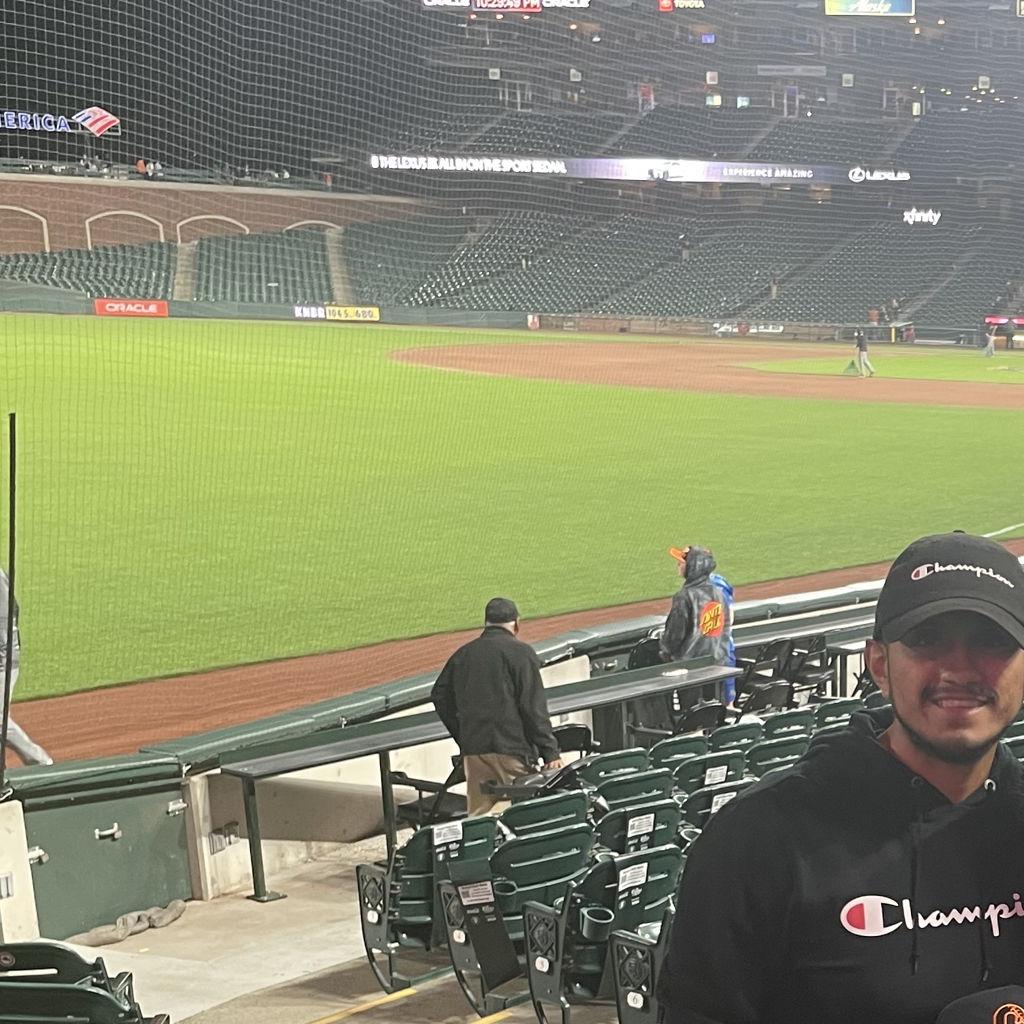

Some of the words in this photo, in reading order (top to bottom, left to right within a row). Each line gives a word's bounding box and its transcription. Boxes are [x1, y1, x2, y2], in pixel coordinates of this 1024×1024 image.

[674, 0, 705, 8] TOYOTA
[0, 111, 72, 132] ERICA
[774, 167, 814, 179] AMAZING
[865, 169, 911, 181] LEXUS
[903, 207, 942, 226] xfinity
[105, 302, 158, 314] ORACLE
[294, 306, 326, 319] KNBR
[911, 562, 1015, 589] Champion
